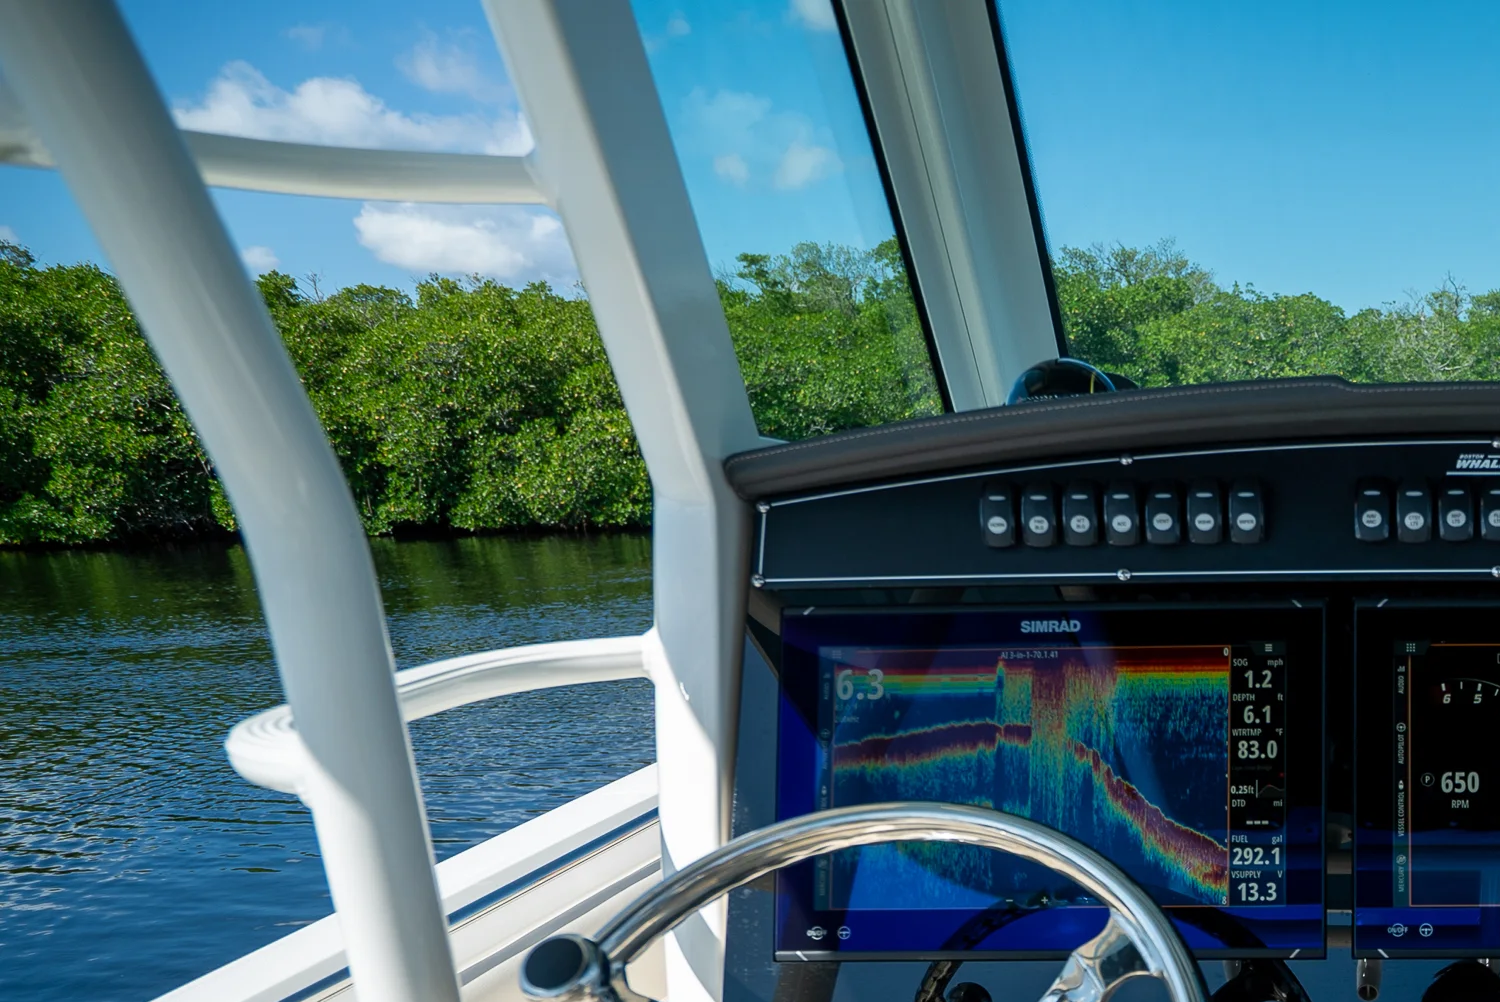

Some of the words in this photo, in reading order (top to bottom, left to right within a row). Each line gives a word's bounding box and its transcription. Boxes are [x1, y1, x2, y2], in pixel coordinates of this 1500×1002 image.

[1020, 620, 1081, 633] SIMRAD
[1232, 658, 1248, 666] SOG
[1267, 658, 1284, 668] mph
[836, 668, 885, 700] 6.3
[1244, 669, 1272, 689] 1.2
[1232, 693, 1255, 702] DEPTH
[1277, 693, 1284, 701] ft
[1442, 693, 1451, 704] 6
[1473, 693, 1482, 704] 5
[1243, 704, 1271, 724] 6.1
[1231, 728, 1262, 737] WTRTMP
[1237, 740, 1278, 759] 83.0
[1440, 771, 1480, 794] 650
[1231, 799, 1246, 808] DTD
[1451, 799, 1470, 809] RPM
[1231, 835, 1248, 843] FUEL
[1271, 834, 1283, 845] gal
[1232, 847, 1280, 866] 292.1
[1231, 870, 1261, 879] VSUPPLY
[1237, 882, 1277, 902] 13.3
